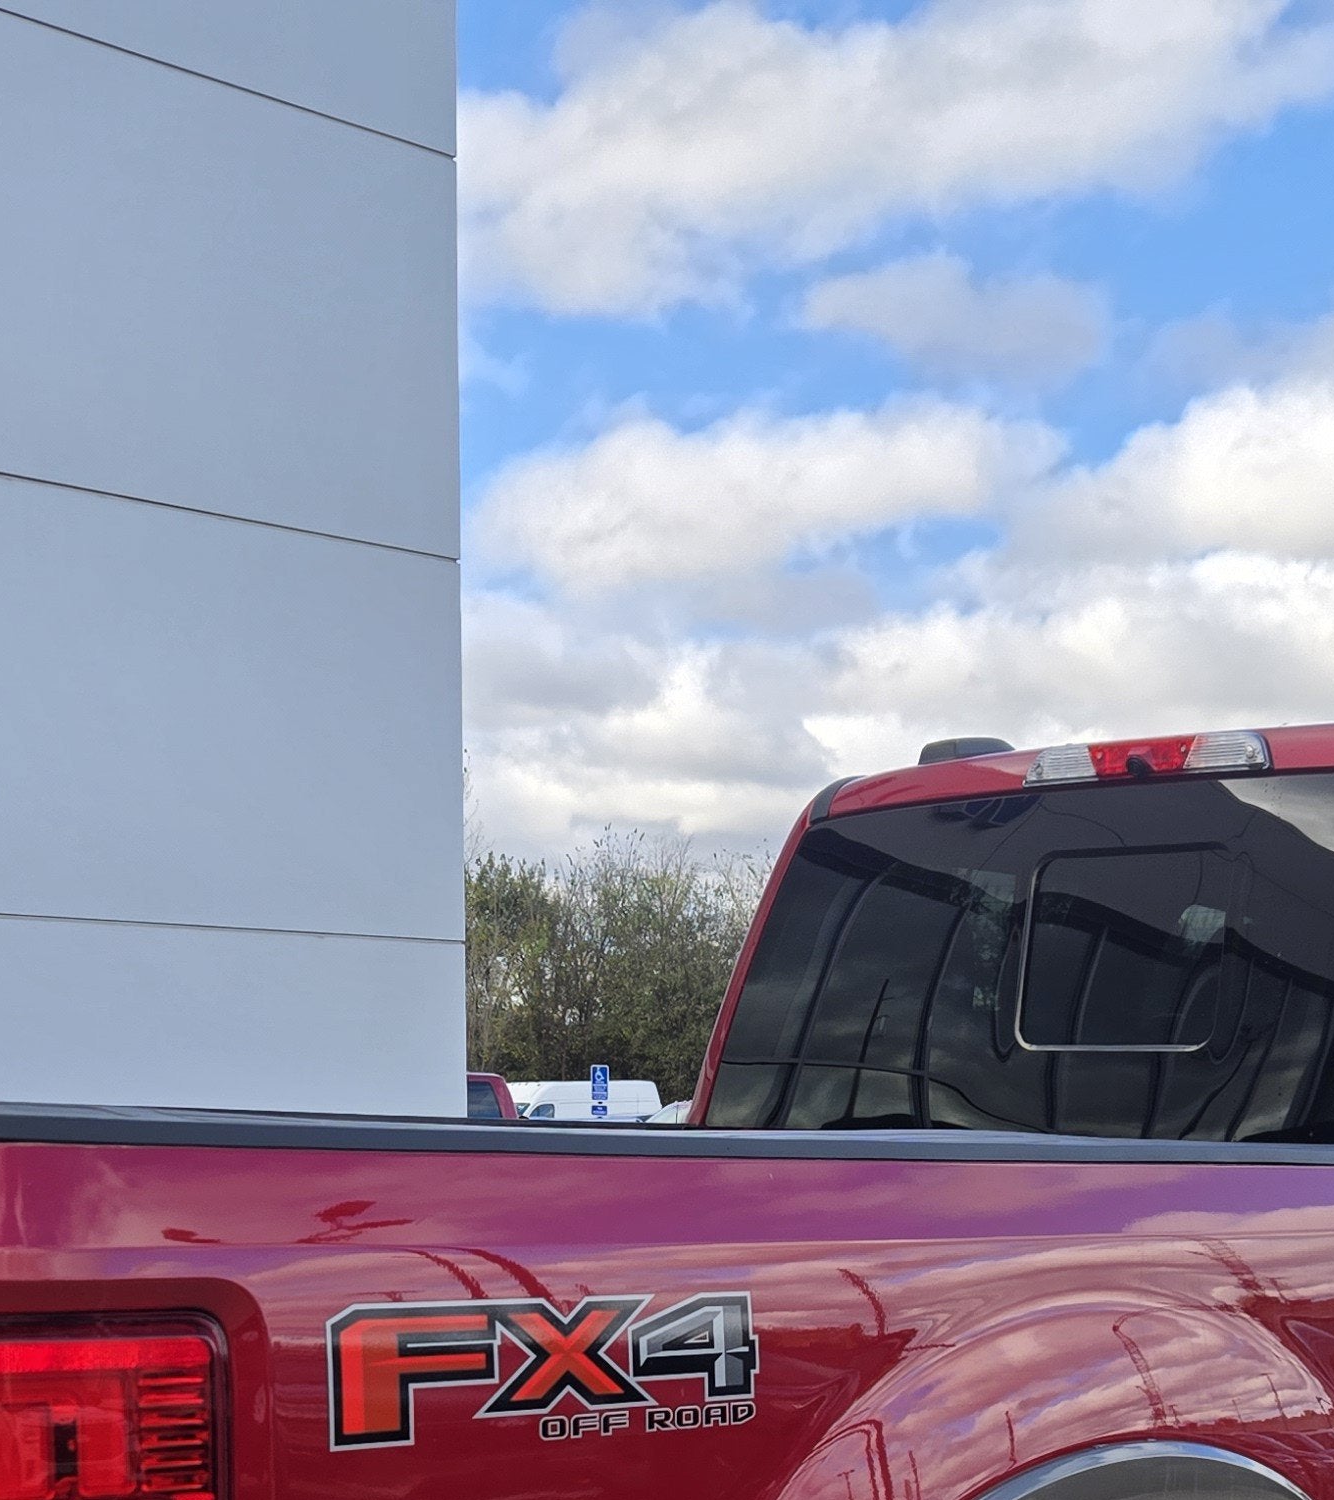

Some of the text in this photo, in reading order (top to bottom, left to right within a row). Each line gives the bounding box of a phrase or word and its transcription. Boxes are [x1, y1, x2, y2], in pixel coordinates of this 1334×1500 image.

[326, 1291, 759, 1452] FX4
[539, 1401, 757, 1442] OFF ROAD
